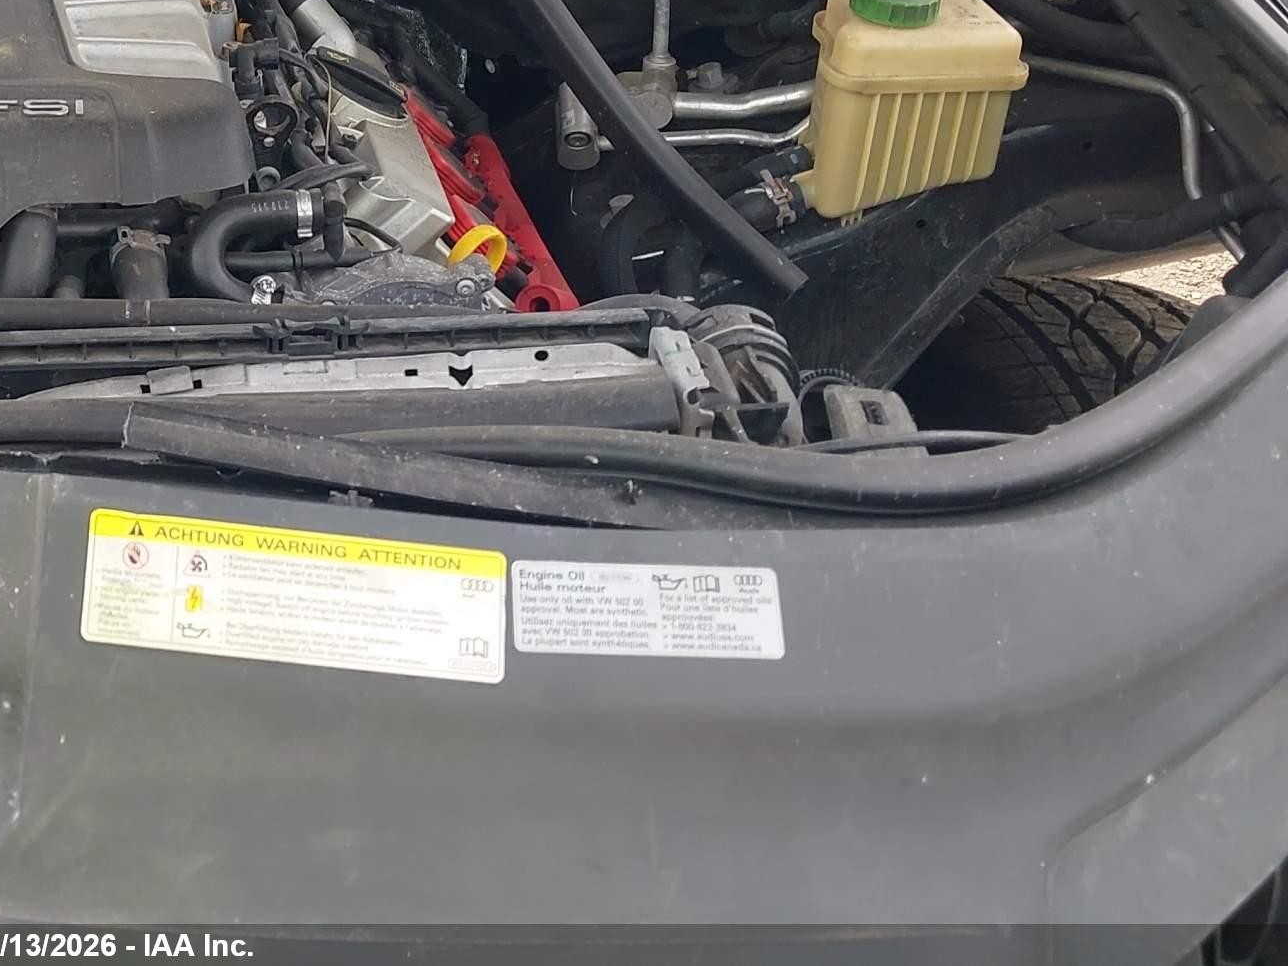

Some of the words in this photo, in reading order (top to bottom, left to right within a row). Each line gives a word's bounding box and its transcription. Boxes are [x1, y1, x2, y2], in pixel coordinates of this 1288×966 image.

[154, 525, 244, 547] ACHTUNG
[255, 536, 347, 558] WARNING
[358, 546, 462, 570] ATTENTION
[519, 569, 563, 581] Engine
[567, 570, 585, 580] Oil
[519, 580, 552, 591] Huile
[556, 584, 606, 592] moteur
[520, 594, 536, 602] Use
[539, 595, 559, 604] only
[561, 595, 572, 603] oil
[575, 596, 593, 604] with
[682, 593, 696, 601] list
[711, 595, 753, 604] approved
[565, 605, 587, 613] Most
[556, 618, 609, 628] uniquement
[613, 619, 627, 627] des
[630, 619, 656, 627] huiles
[522, 636, 532, 644] La
[535, 637, 566, 647] plupart
